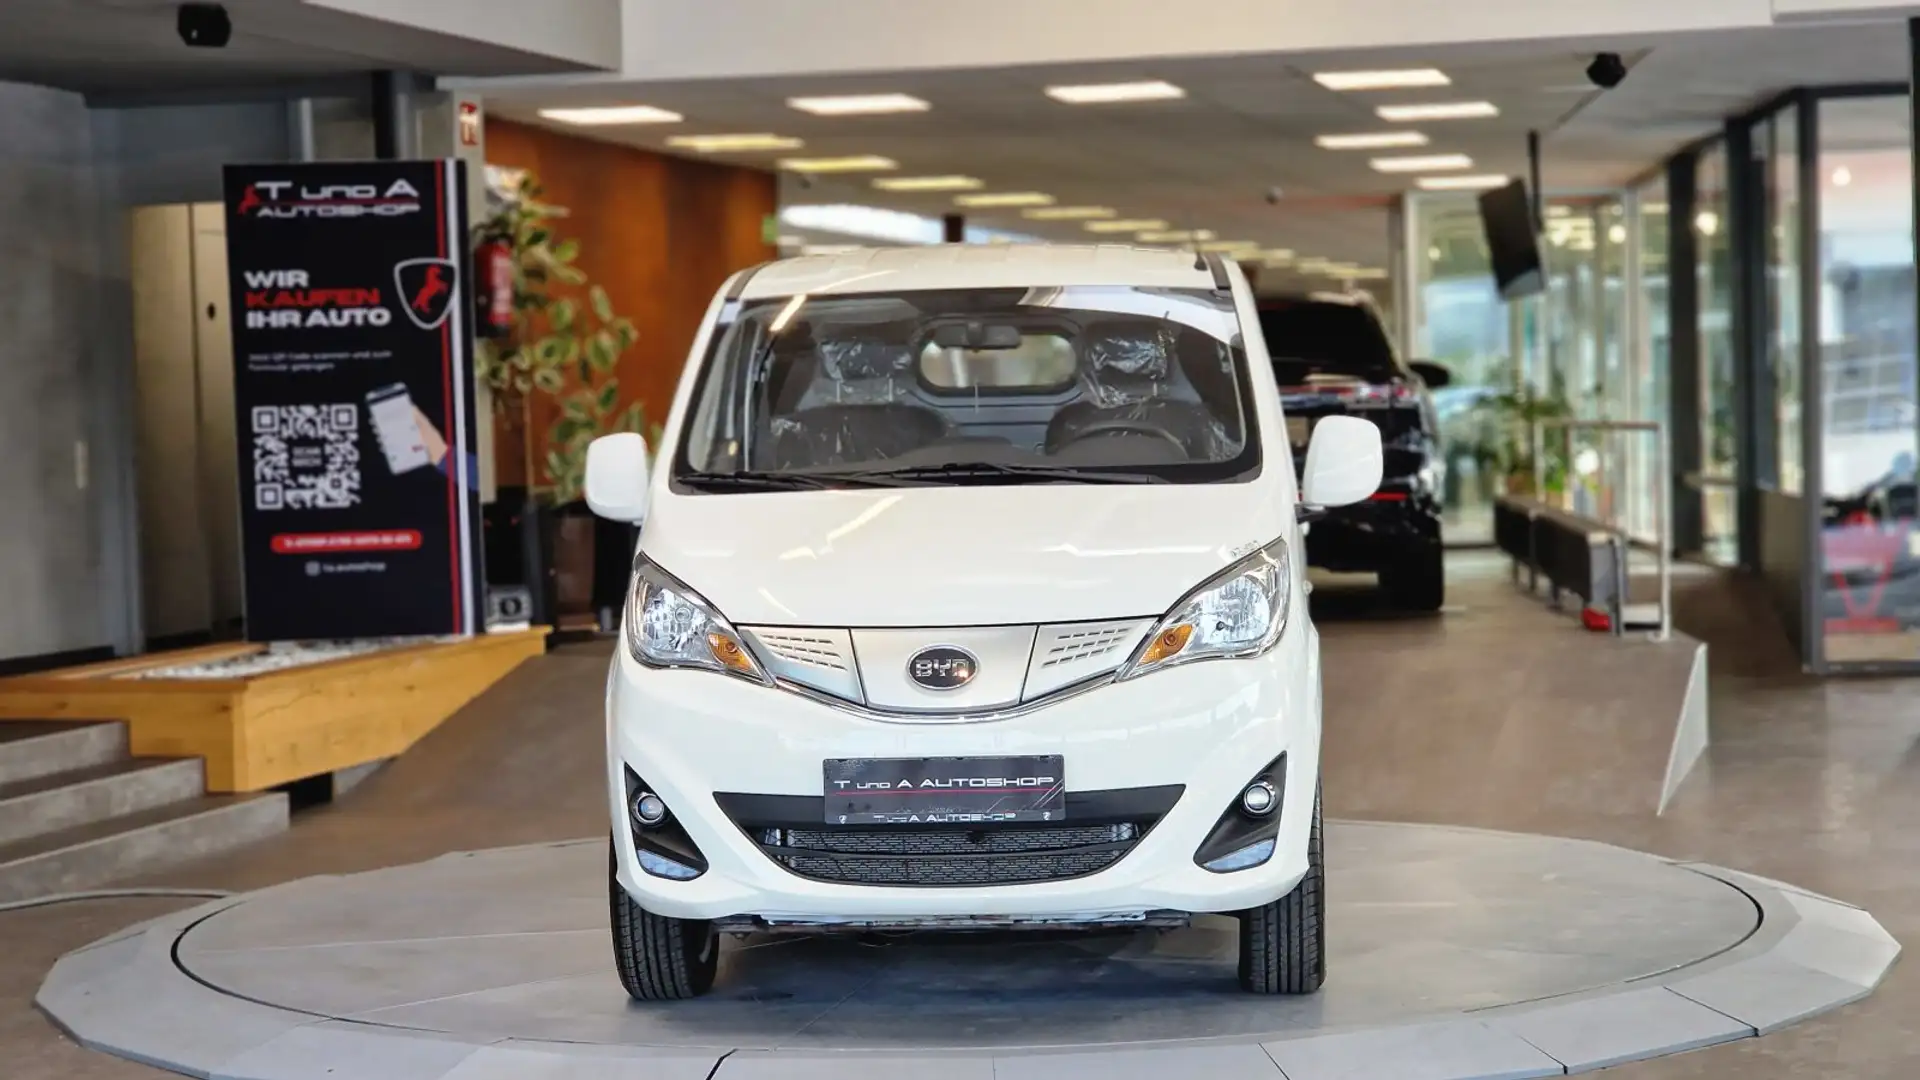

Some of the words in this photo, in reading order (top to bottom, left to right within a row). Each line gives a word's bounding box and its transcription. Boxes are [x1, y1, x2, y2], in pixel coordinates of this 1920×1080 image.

[255, 181, 293, 199] T
[384, 178, 420, 198] A
[256, 203, 422, 218] AUTOSHOP
[244, 269, 310, 288] WIR
[245, 288, 381, 307] KAUFEN
[246, 310, 301, 329] IHR
[304, 308, 392, 328] AUTO
[915, 658, 970, 677] BYD
[833, 780, 851, 790] T
[896, 779, 914, 789] A
[920, 777, 1055, 789] AUTOSHOP
